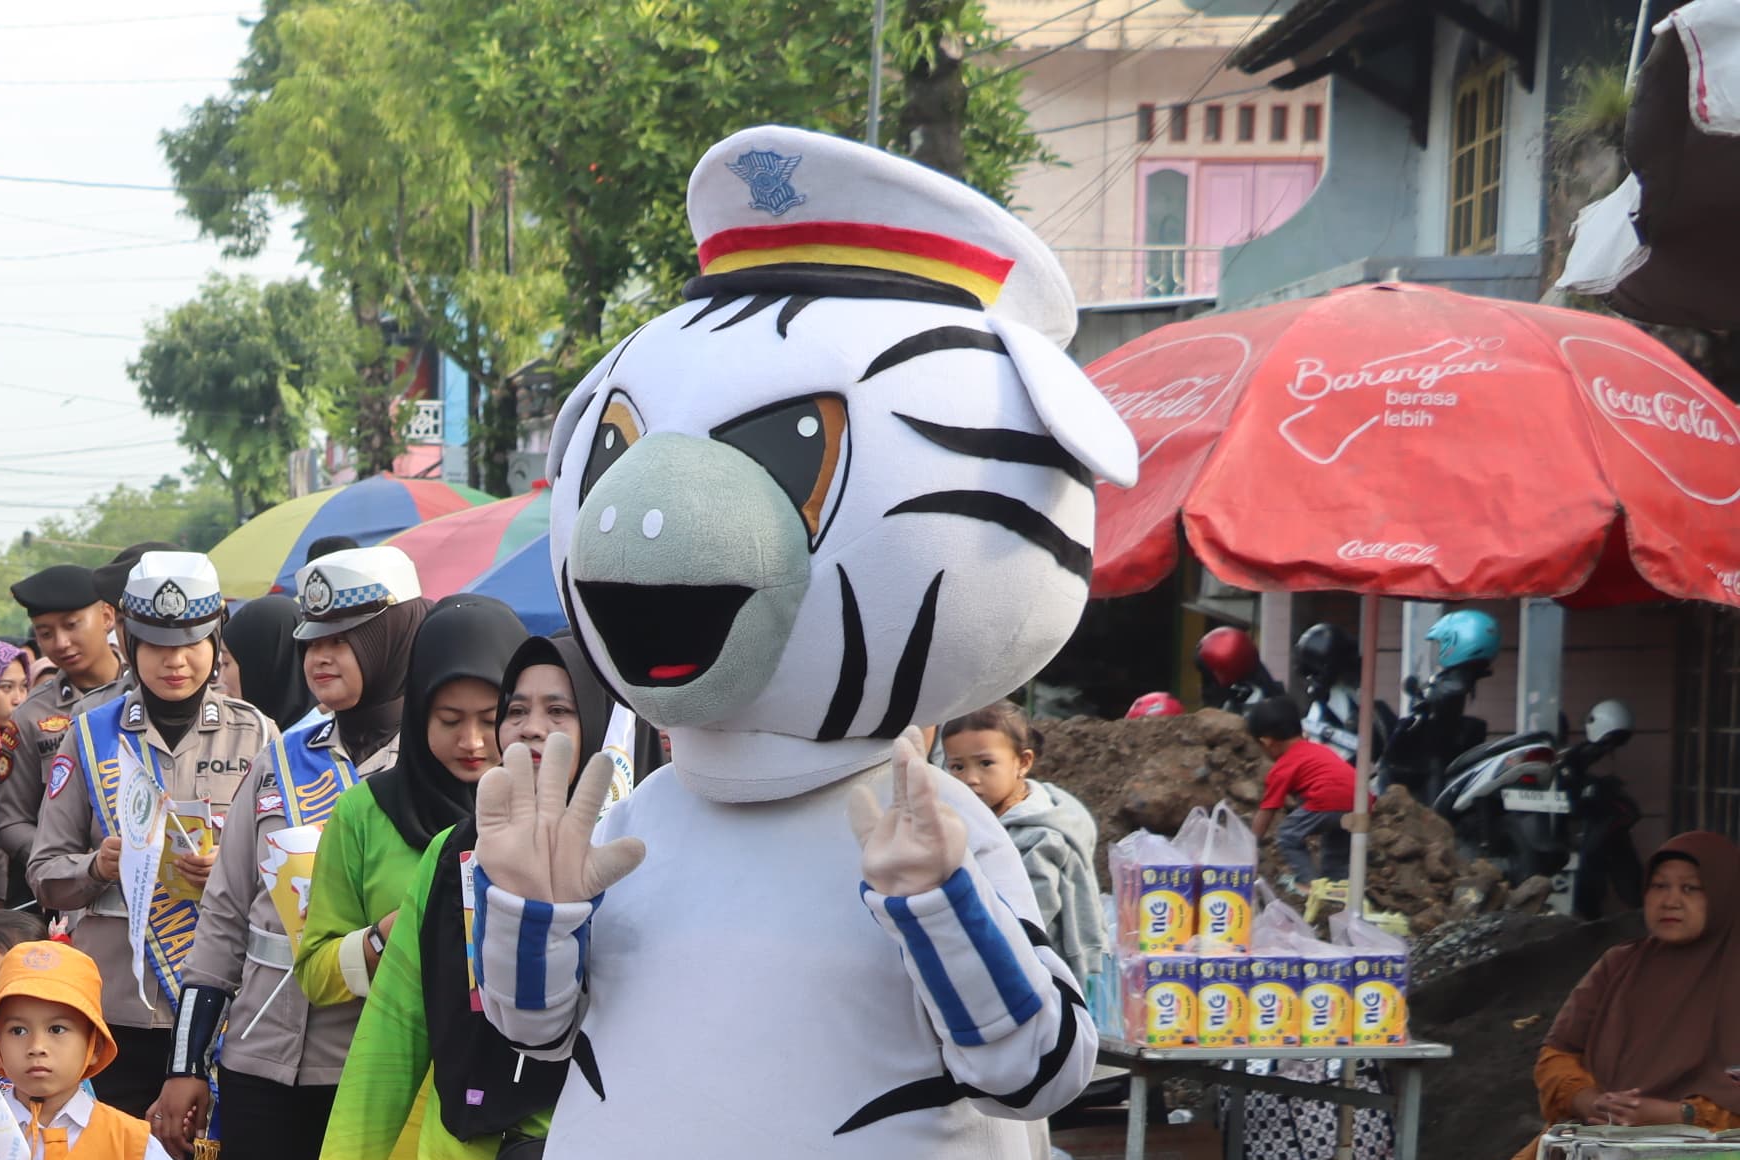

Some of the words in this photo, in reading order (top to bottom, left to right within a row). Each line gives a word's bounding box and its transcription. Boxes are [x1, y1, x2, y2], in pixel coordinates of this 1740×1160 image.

[1286, 358, 1498, 401] Barengan
[1386, 388, 1458, 406] berasa
[1384, 409, 1433, 427] lebih
[197, 757, 249, 774] POLR
